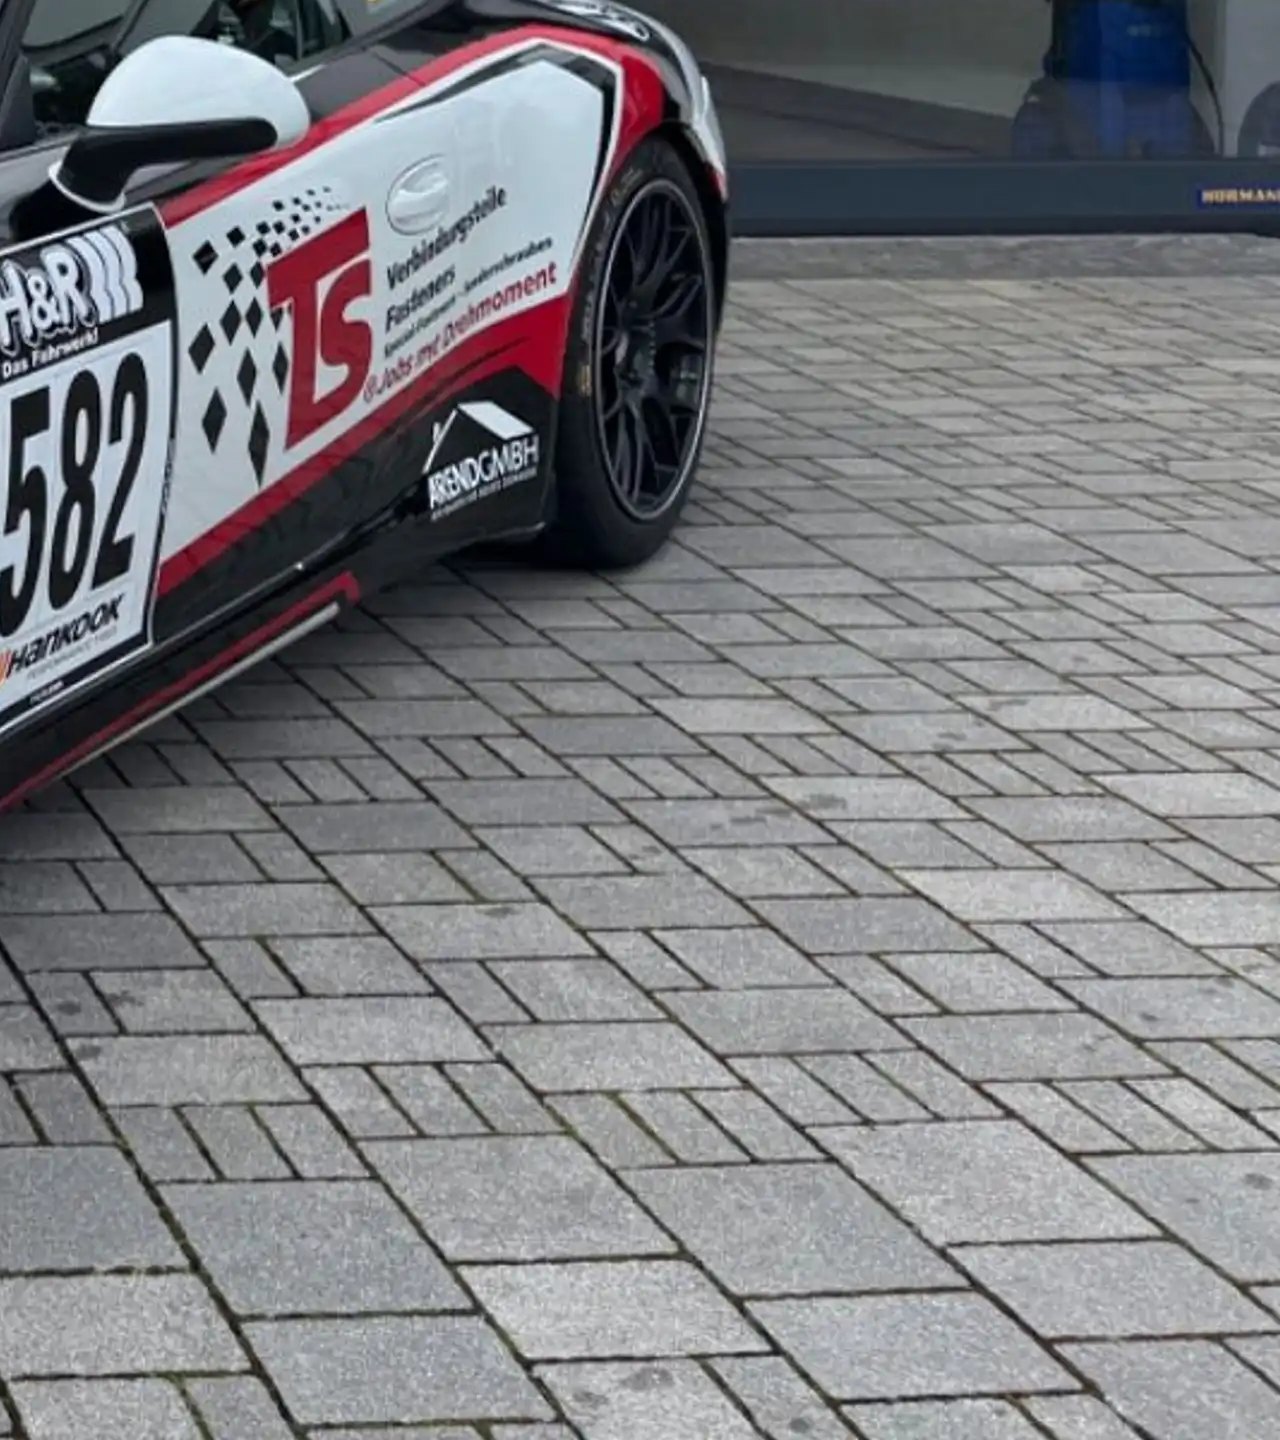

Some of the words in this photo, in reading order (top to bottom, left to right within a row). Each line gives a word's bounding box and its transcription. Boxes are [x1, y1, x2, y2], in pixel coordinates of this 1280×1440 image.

[387, 185, 507, 290] Verbindungsteile
[266, 205, 372, 450] TS
[442, 261, 557, 351] Drehmoment
